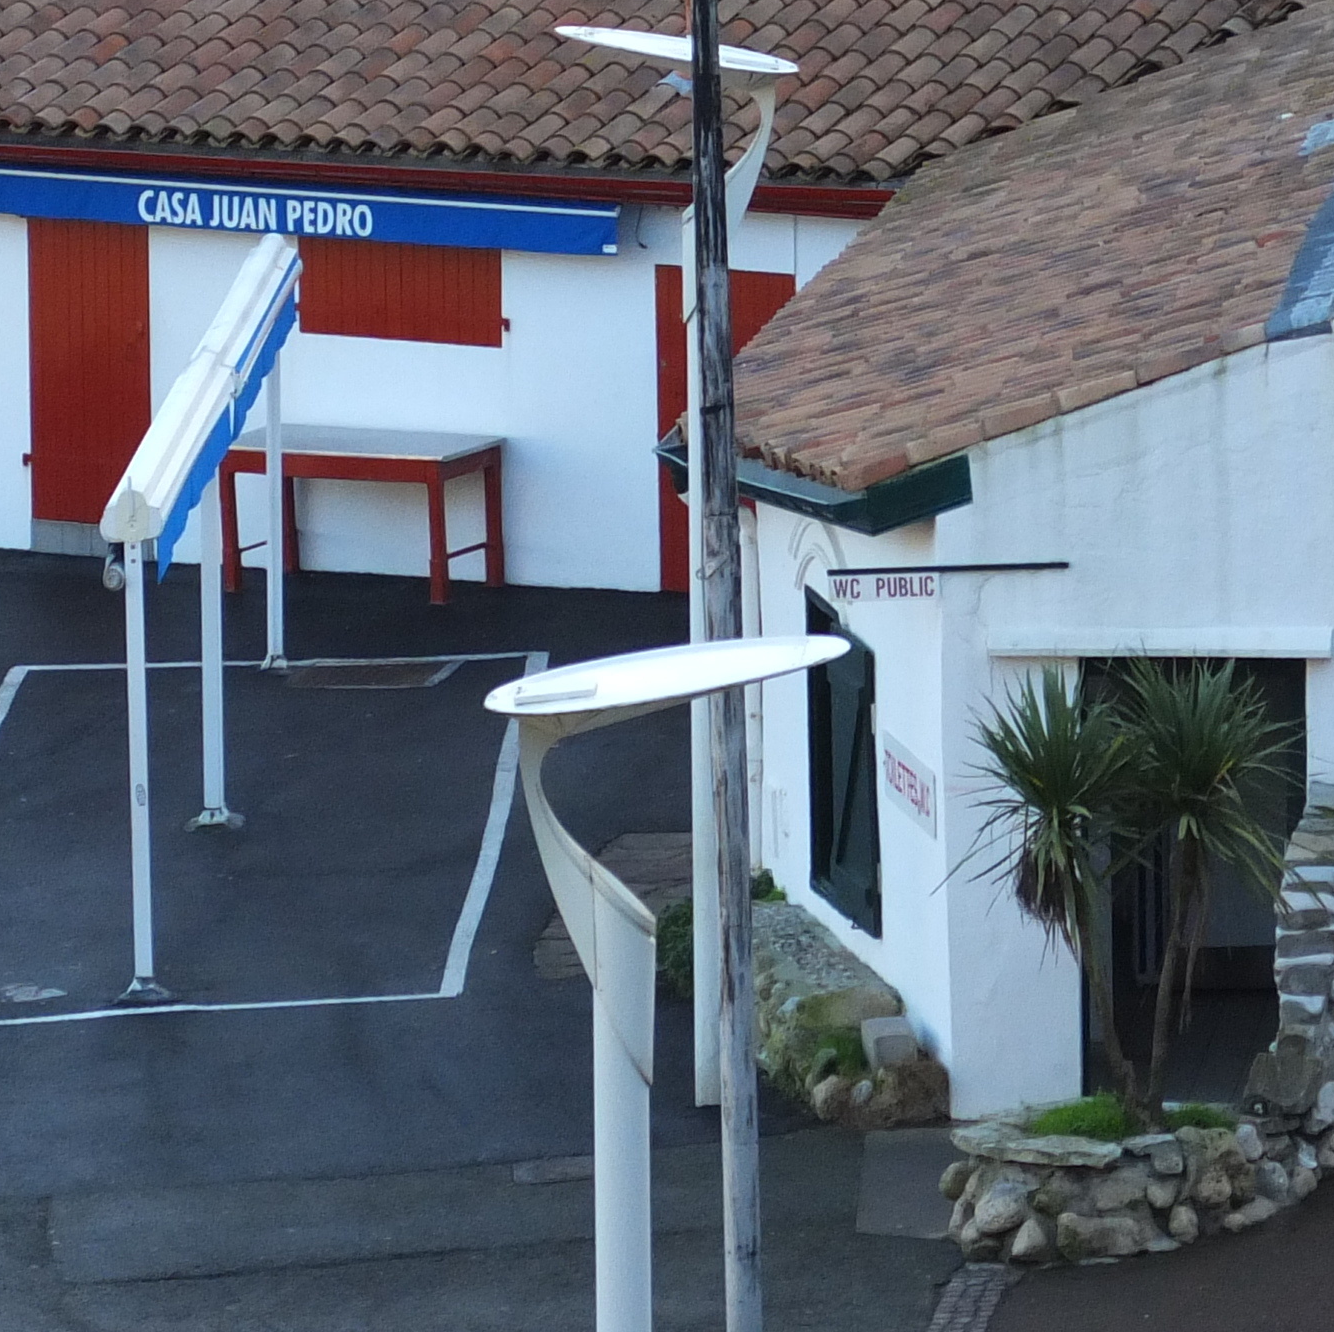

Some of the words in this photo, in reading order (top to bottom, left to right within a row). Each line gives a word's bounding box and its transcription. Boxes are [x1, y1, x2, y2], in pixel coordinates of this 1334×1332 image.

[138, 190, 203, 225] CASA
[210, 194, 277, 230] JUAN
[286, 199, 373, 237] PEDRO
[833, 578, 861, 599] WC
[876, 576, 935, 598] PUBLIC
